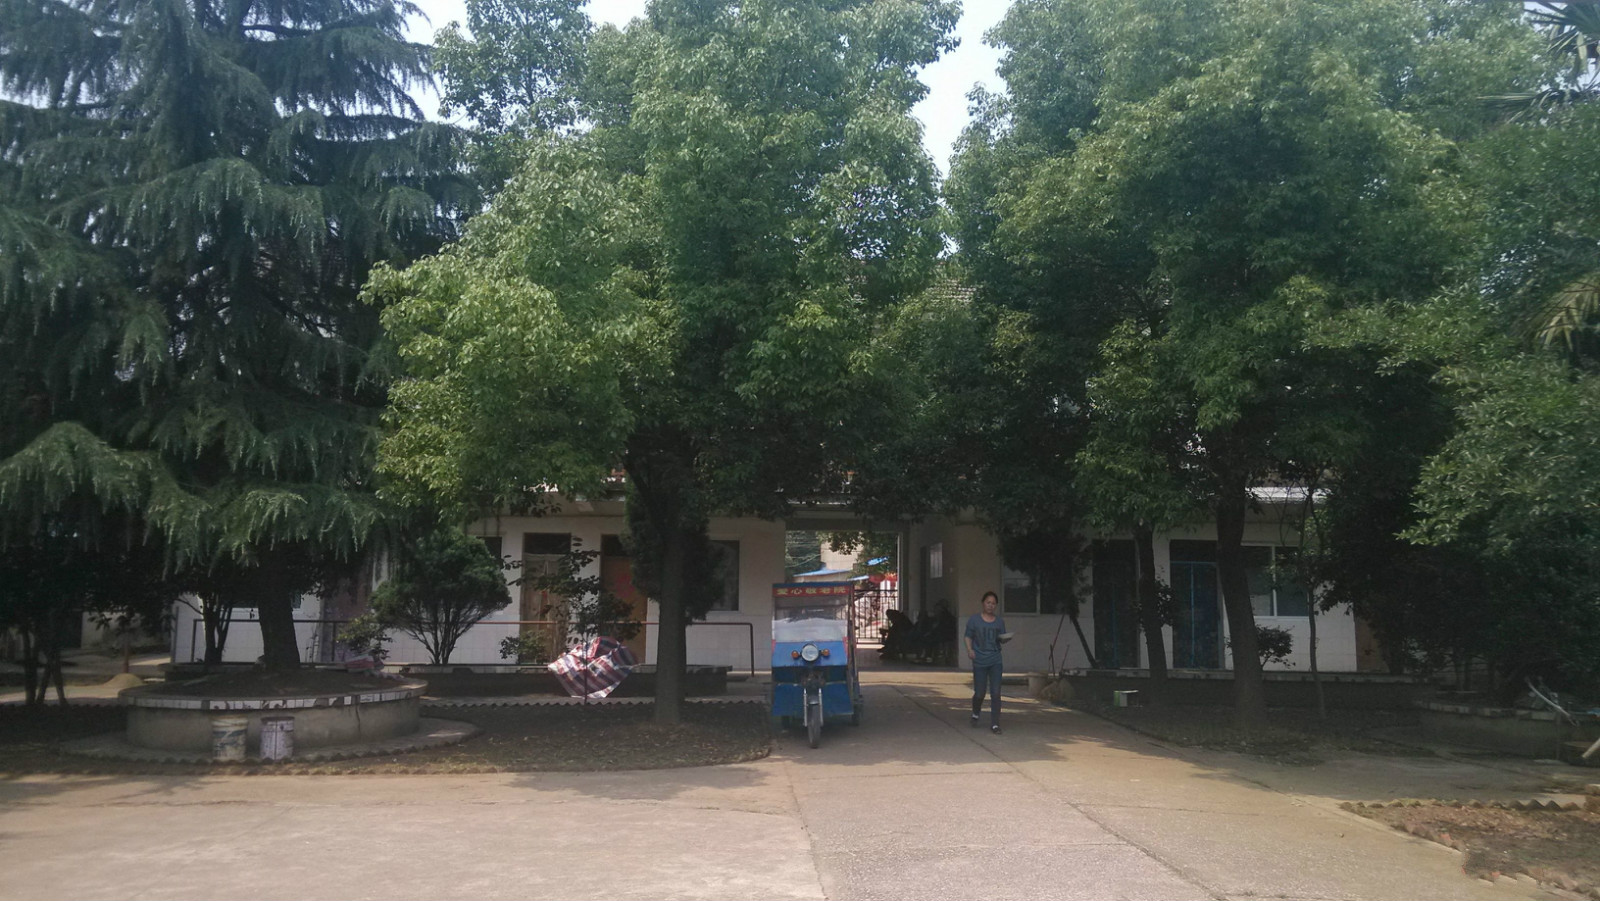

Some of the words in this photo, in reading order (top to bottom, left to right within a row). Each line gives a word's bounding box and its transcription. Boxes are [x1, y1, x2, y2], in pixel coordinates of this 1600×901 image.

[776, 586, 846, 595] 爱心敬老院
